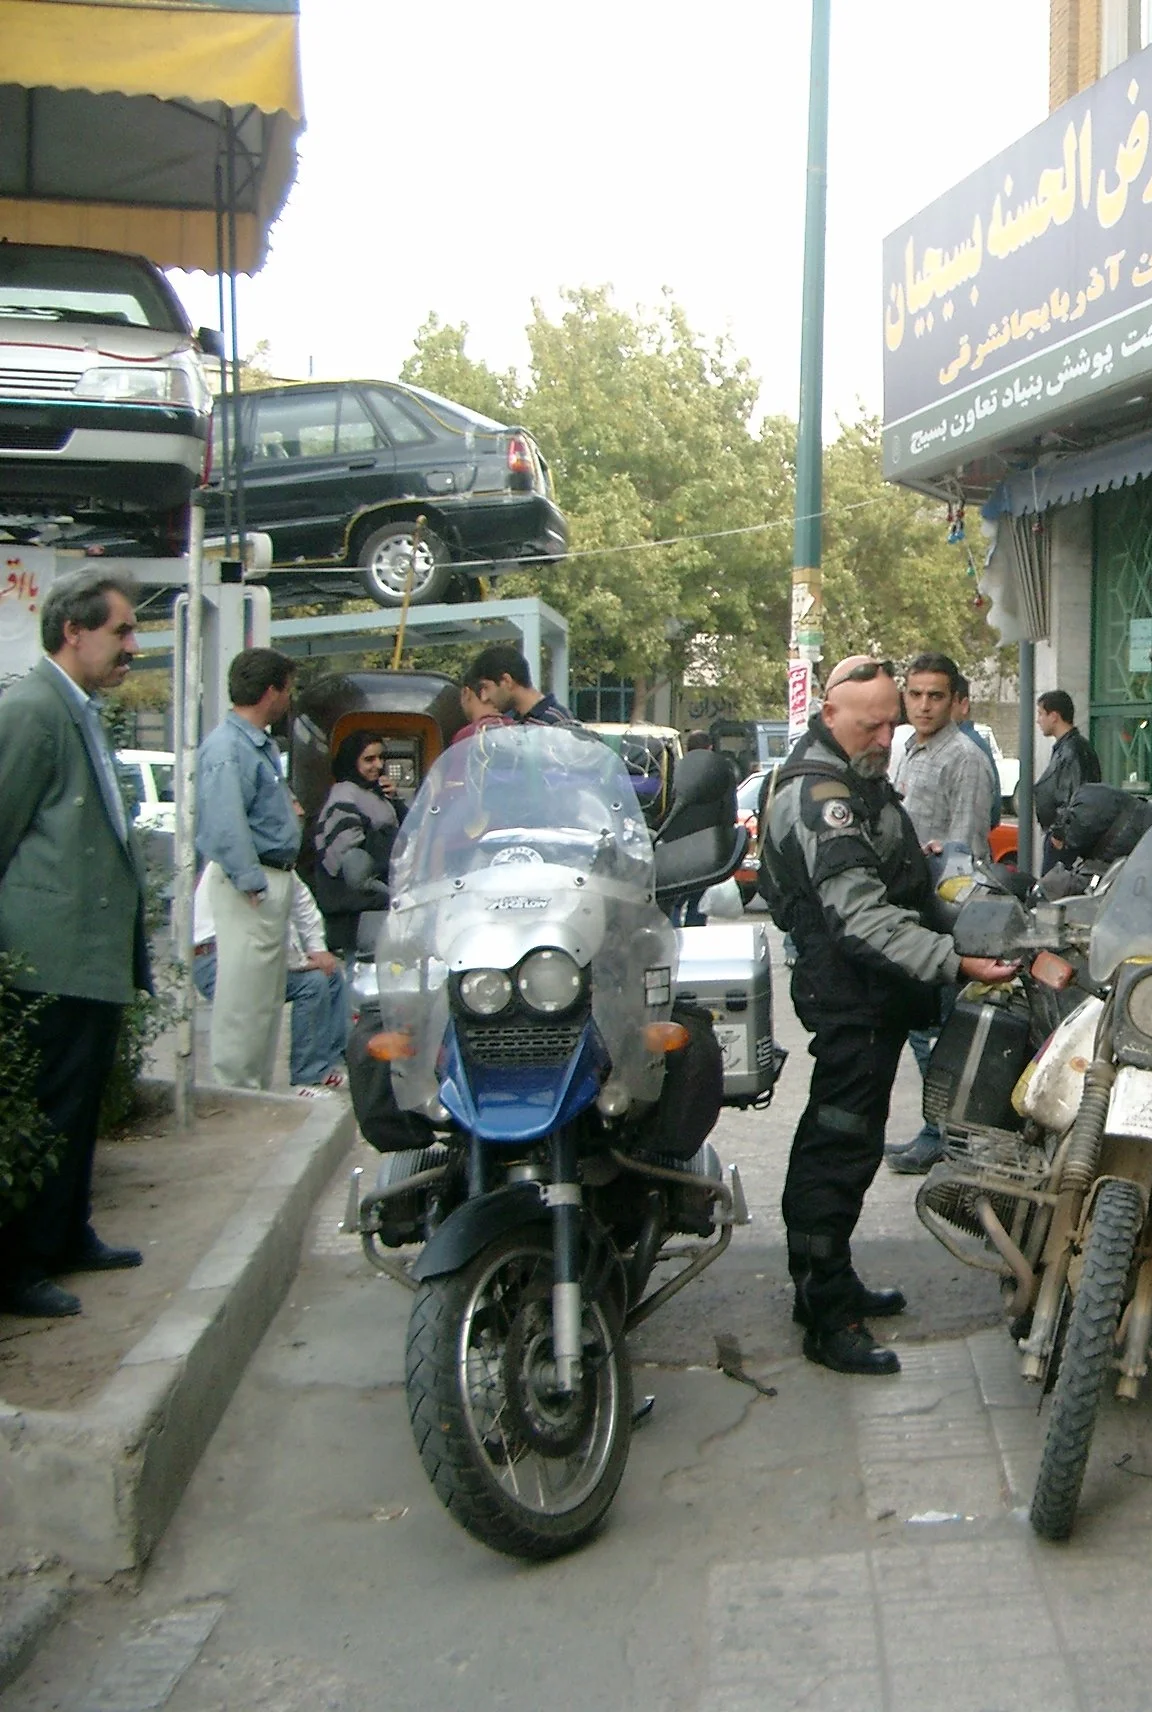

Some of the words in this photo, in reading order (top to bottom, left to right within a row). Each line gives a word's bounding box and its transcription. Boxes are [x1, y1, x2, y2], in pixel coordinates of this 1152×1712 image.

[987, 109, 1092, 260] الحسنه
[884, 212, 983, 352] بسیجیان
[1001, 374, 1043, 408] بنیاد
[1046, 343, 1114, 397] پوشش
[909, 418, 948, 454] بسیج
[950, 387, 998, 438] تعاون
